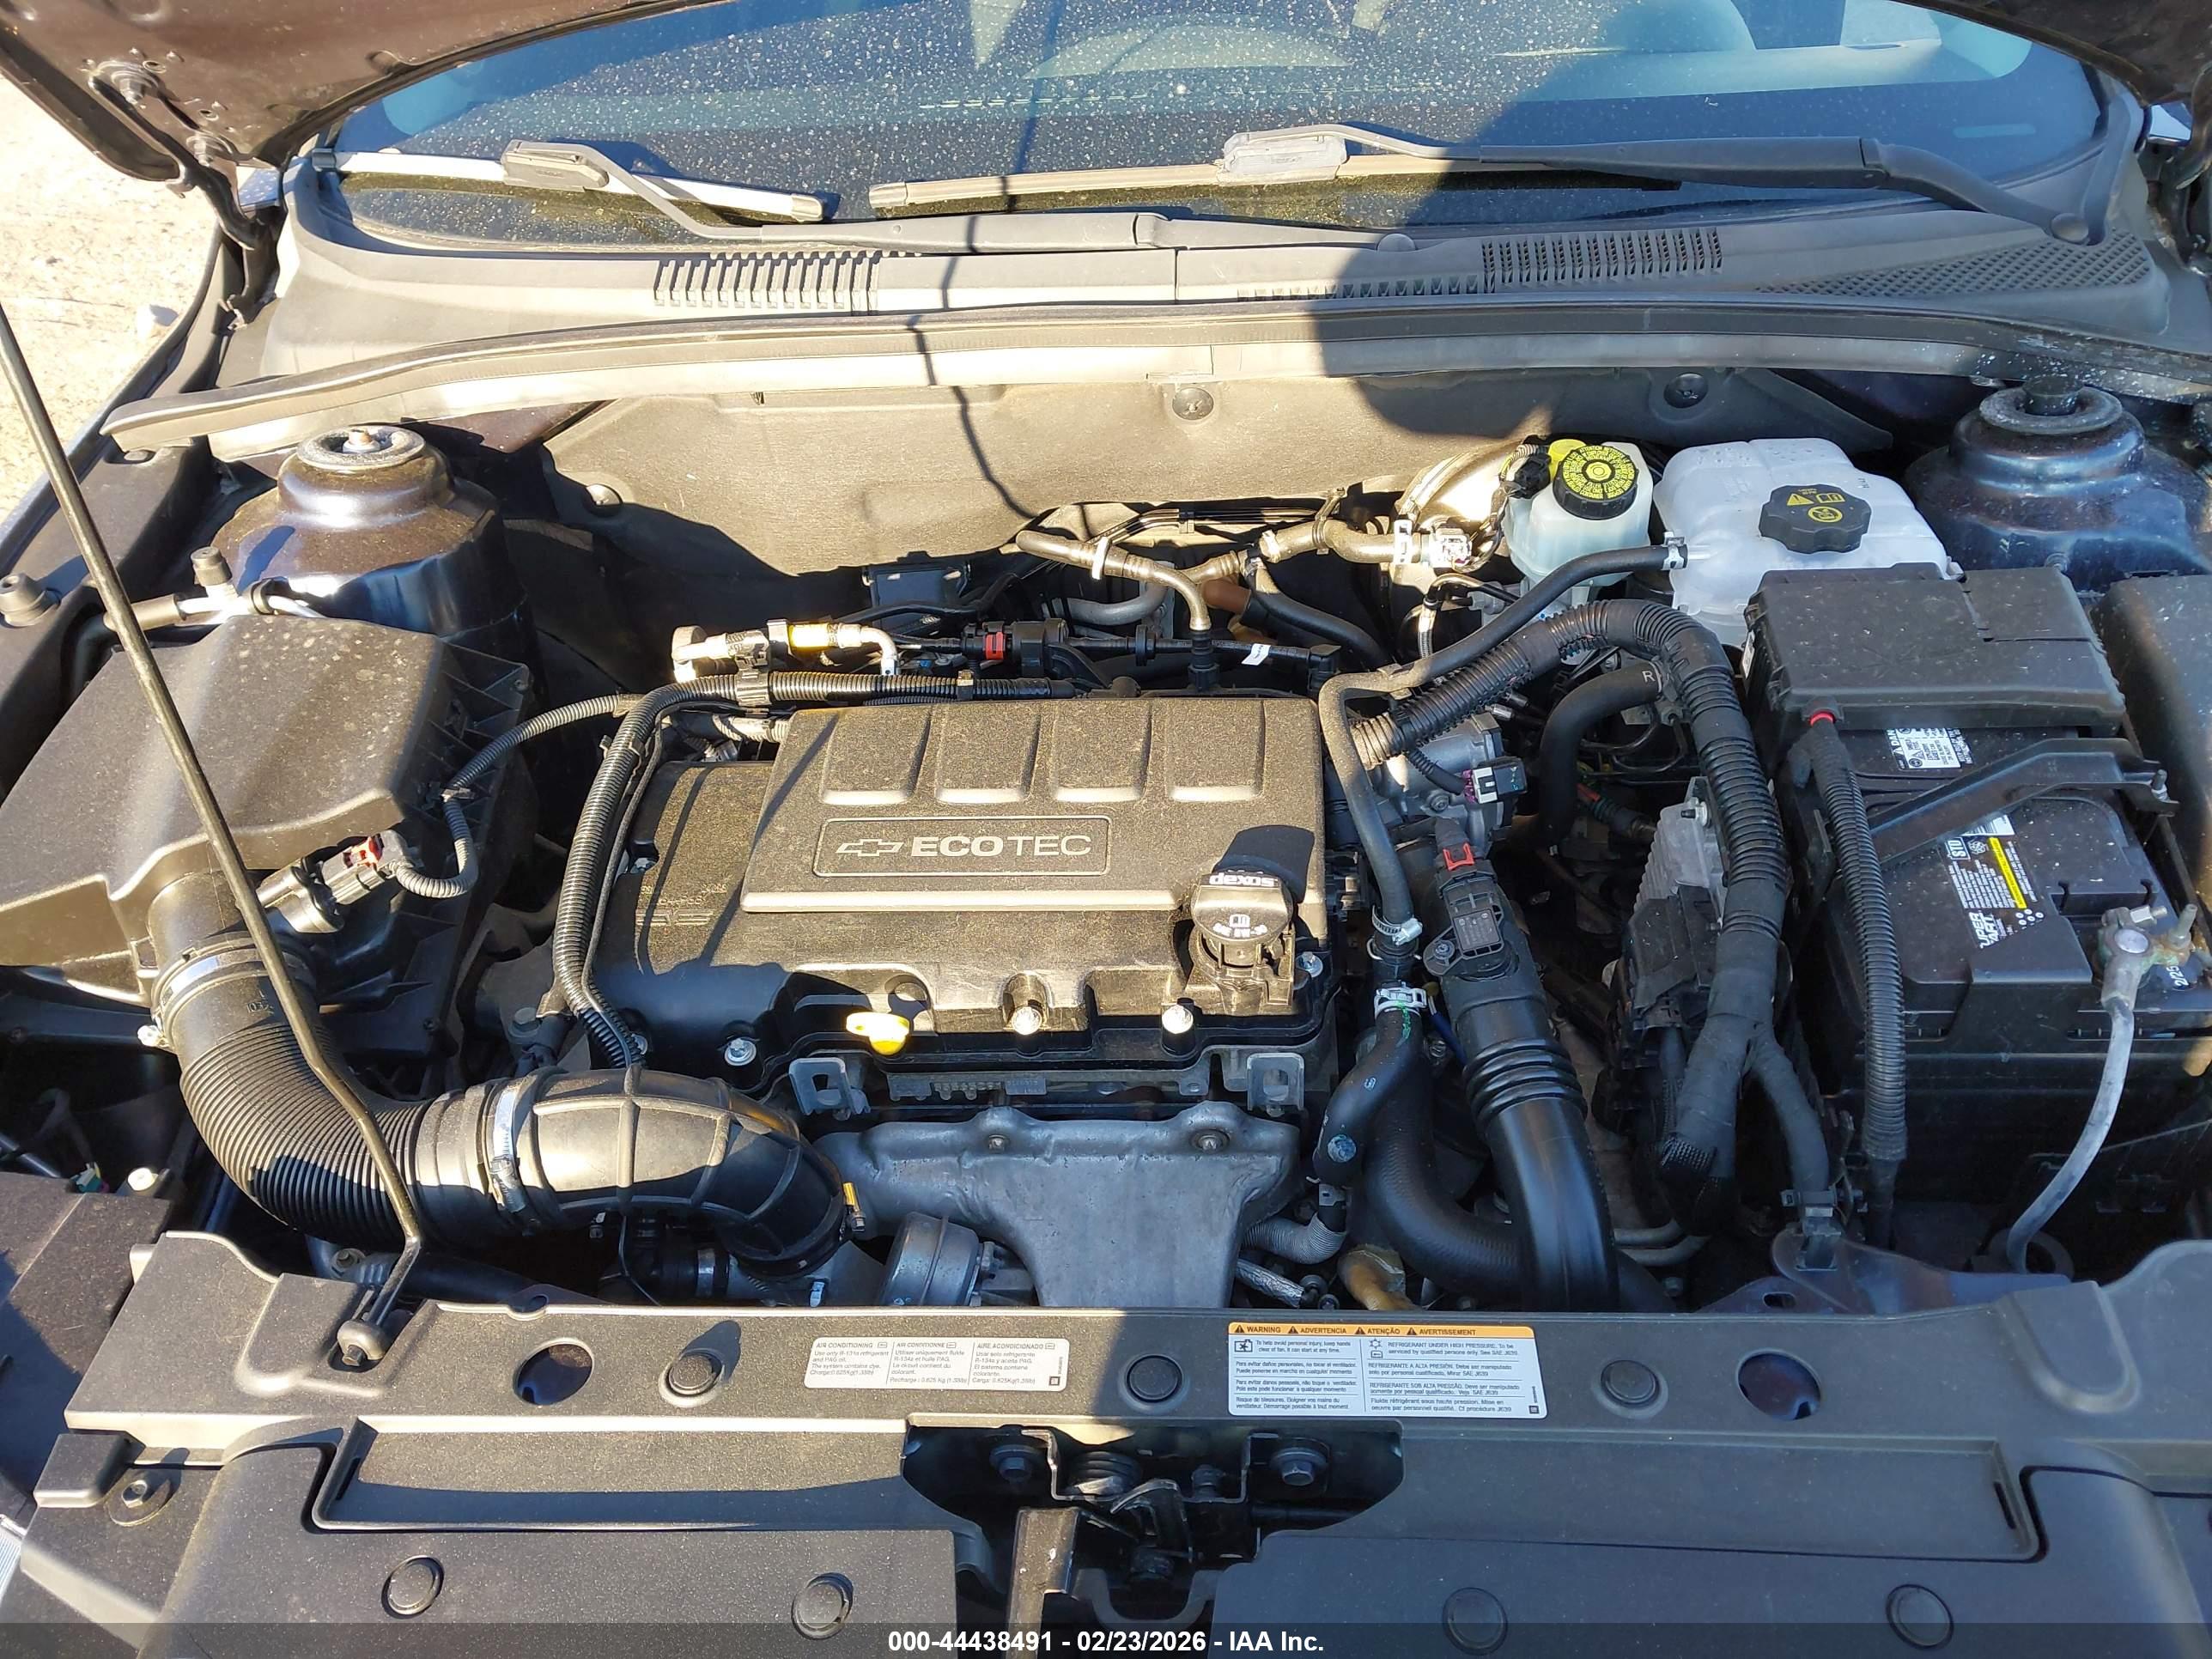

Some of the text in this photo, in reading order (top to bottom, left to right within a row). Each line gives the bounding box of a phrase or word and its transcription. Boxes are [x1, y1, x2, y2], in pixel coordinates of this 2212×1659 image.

[1642, 671, 1656, 682] R
[911, 835, 1091, 857] ECOTEC
[1948, 840, 1966, 857] STD
[1209, 872, 1274, 887] dexos
